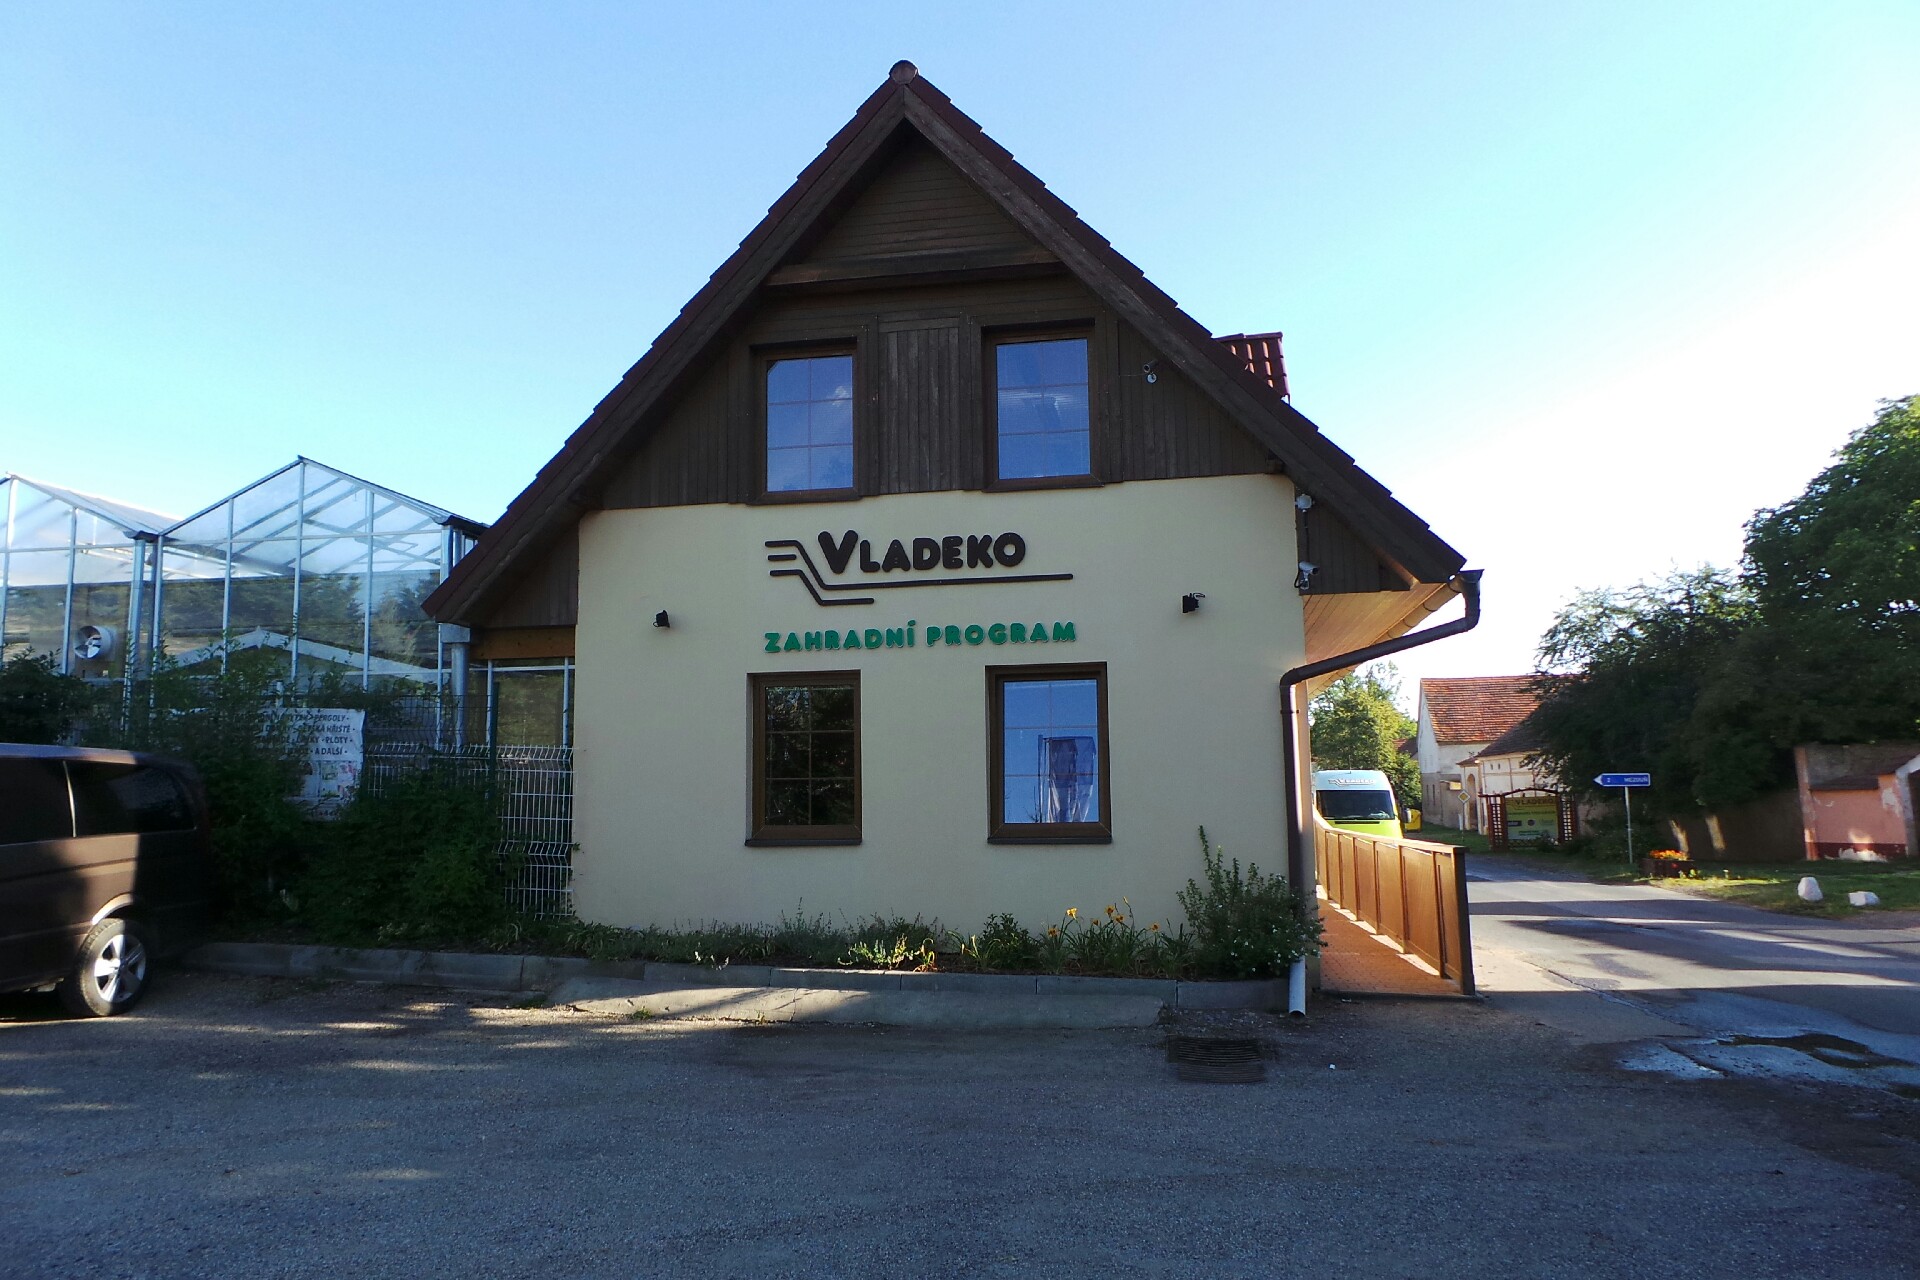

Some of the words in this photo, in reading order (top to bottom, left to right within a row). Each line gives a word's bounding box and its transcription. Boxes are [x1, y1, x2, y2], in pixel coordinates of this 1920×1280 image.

[818, 529, 1026, 574] VLADEKO
[764, 619, 916, 653] ZAHRADNÍ
[926, 621, 1077, 647] PROGRAM
[325, 736, 348, 744] PLOTY
[314, 747, 320, 755] A
